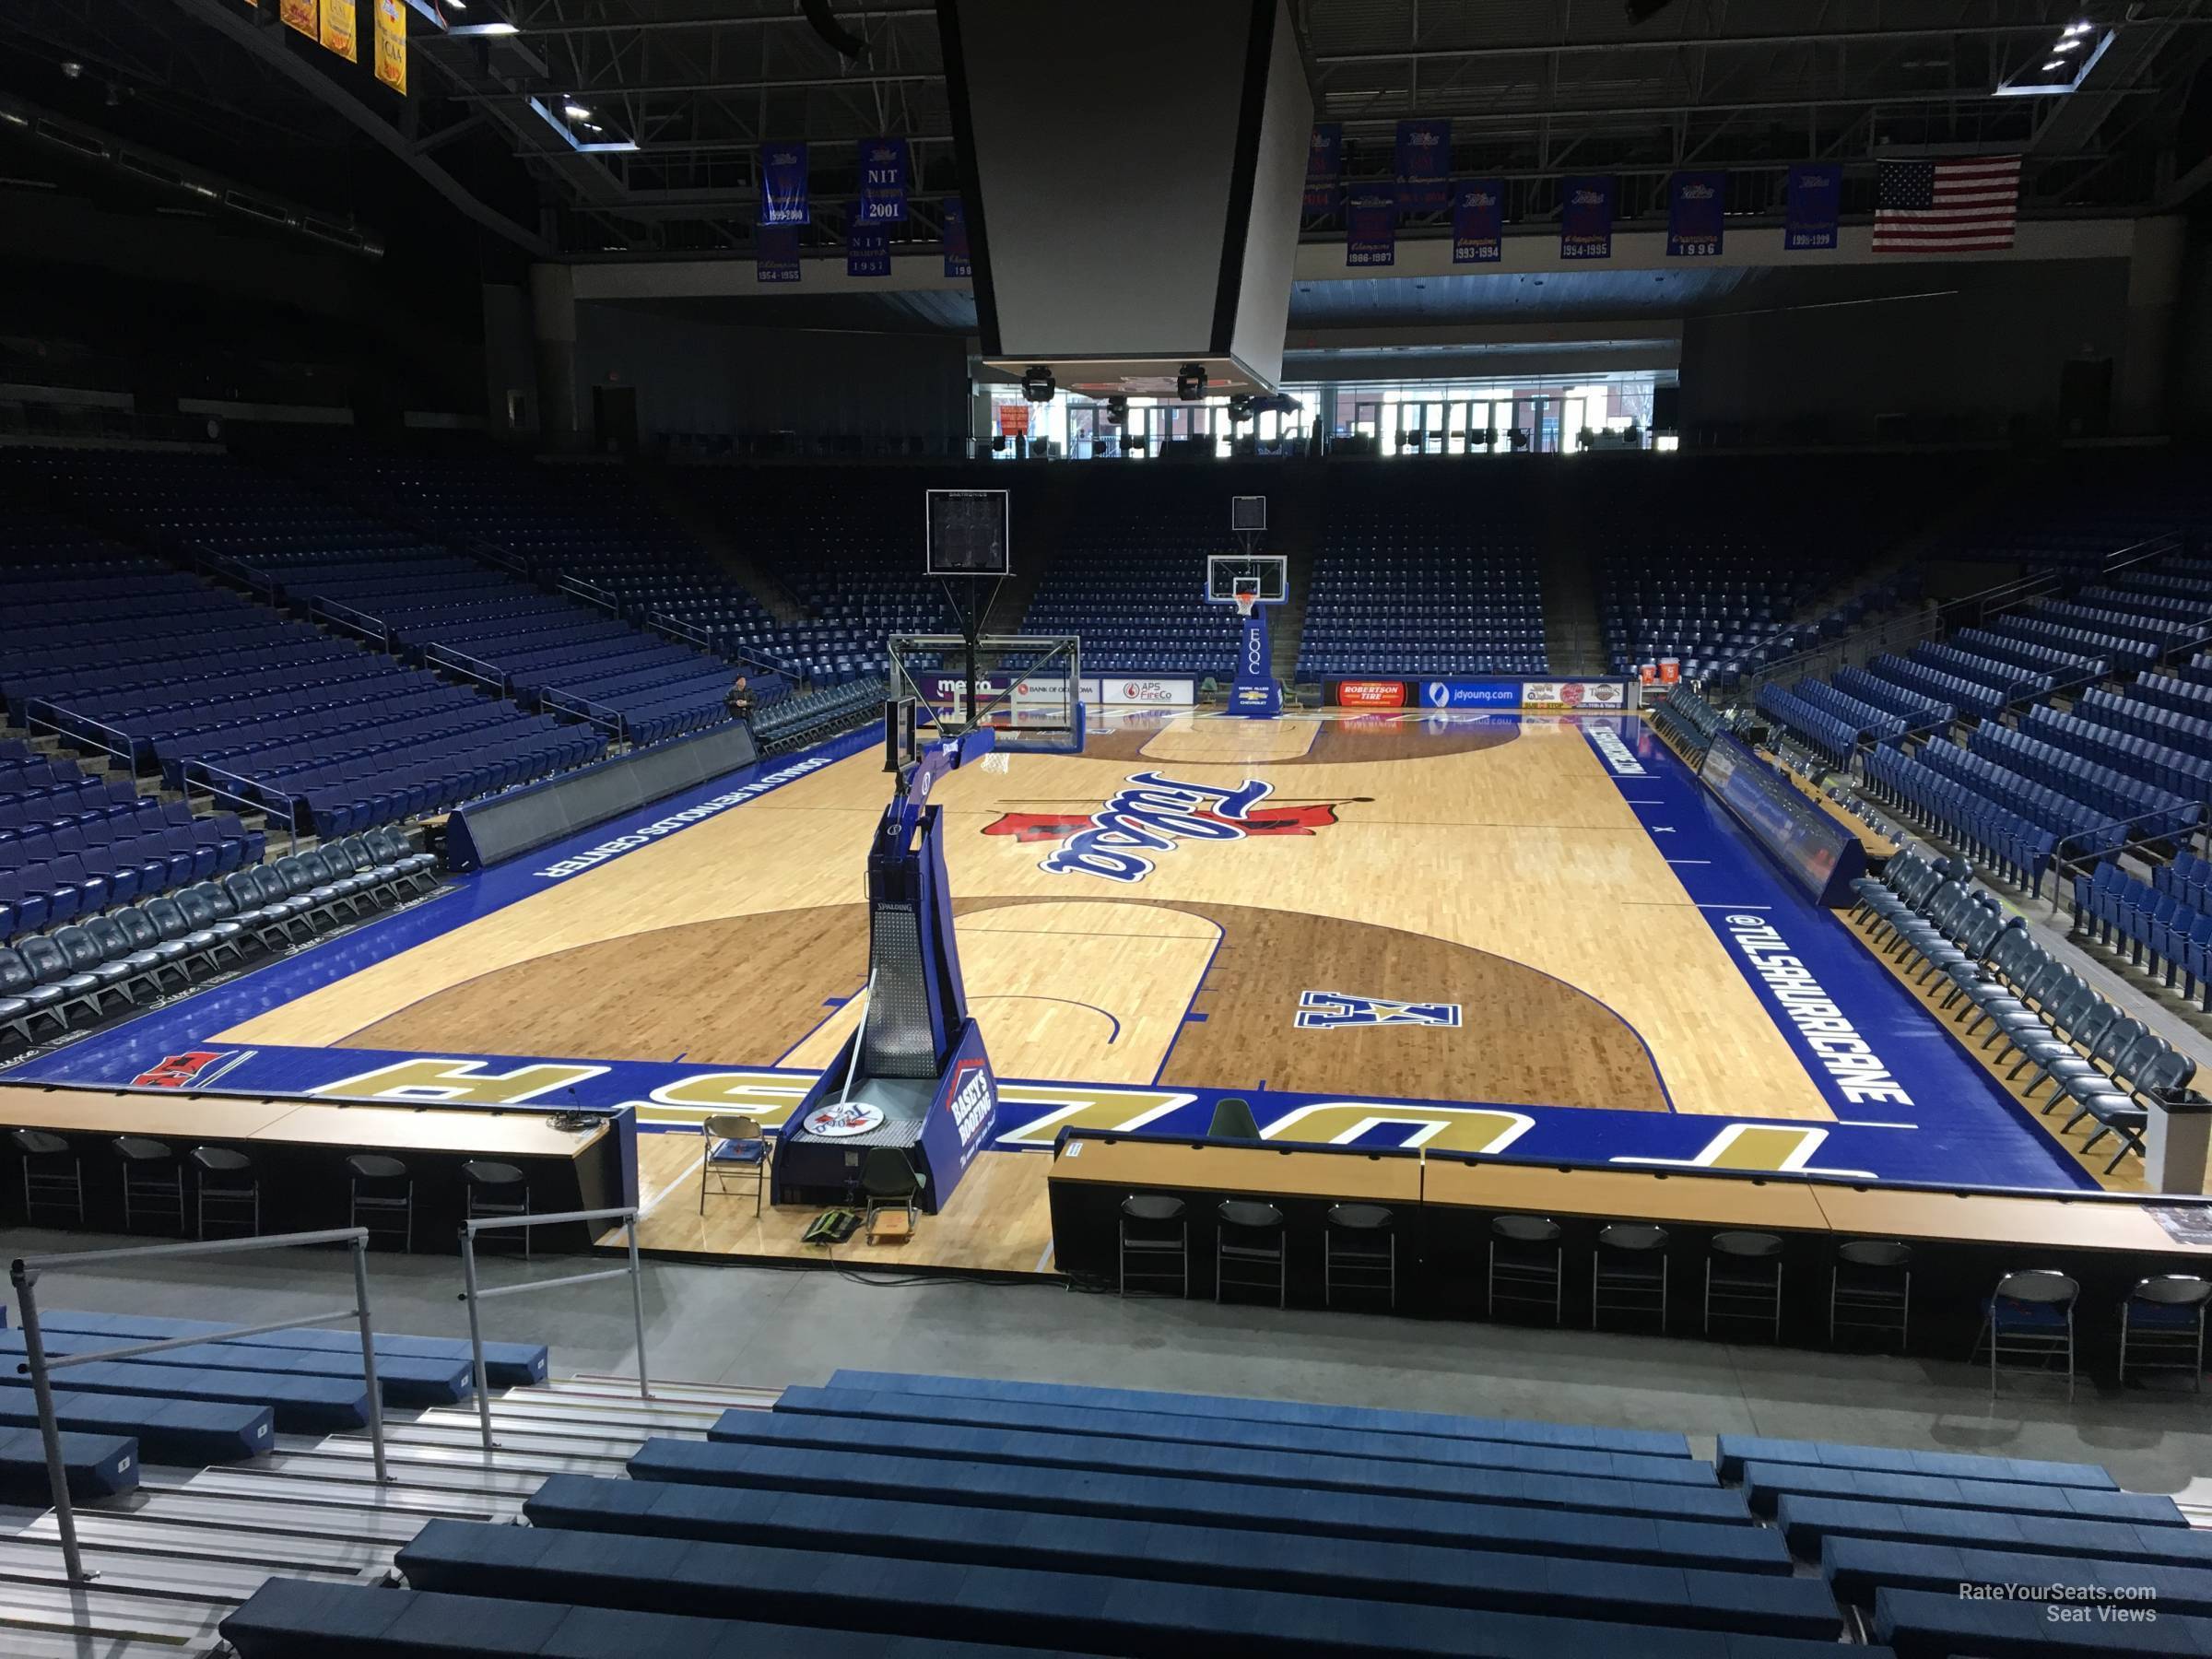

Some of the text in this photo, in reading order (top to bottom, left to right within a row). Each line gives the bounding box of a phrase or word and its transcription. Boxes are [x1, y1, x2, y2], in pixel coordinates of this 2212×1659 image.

[868, 170, 898, 183] NIT
[869, 204, 899, 218] 2001
[1455, 247, 1499, 259] 1993-1994
[1562, 243, 1607, 256] 1994-1995
[1678, 243, 1715, 255] 1996
[937, 679, 992, 692] mero
[1142, 683, 1161, 691] APS
[1453, 688, 1513, 701] jdyoung.com
[761, 758, 833, 783] DONALD
[643, 791, 752, 836] REYNOLDS
[1038, 771, 1276, 883] Tulsa
[532, 833, 651, 878] CENTER
[877, 902, 912, 912] SPALDING
[1725, 914, 1915, 1106] @TULSAHURRICANE
[951, 1069, 987, 1126] BASEY'S
[959, 1091, 992, 1147] ROOFING
